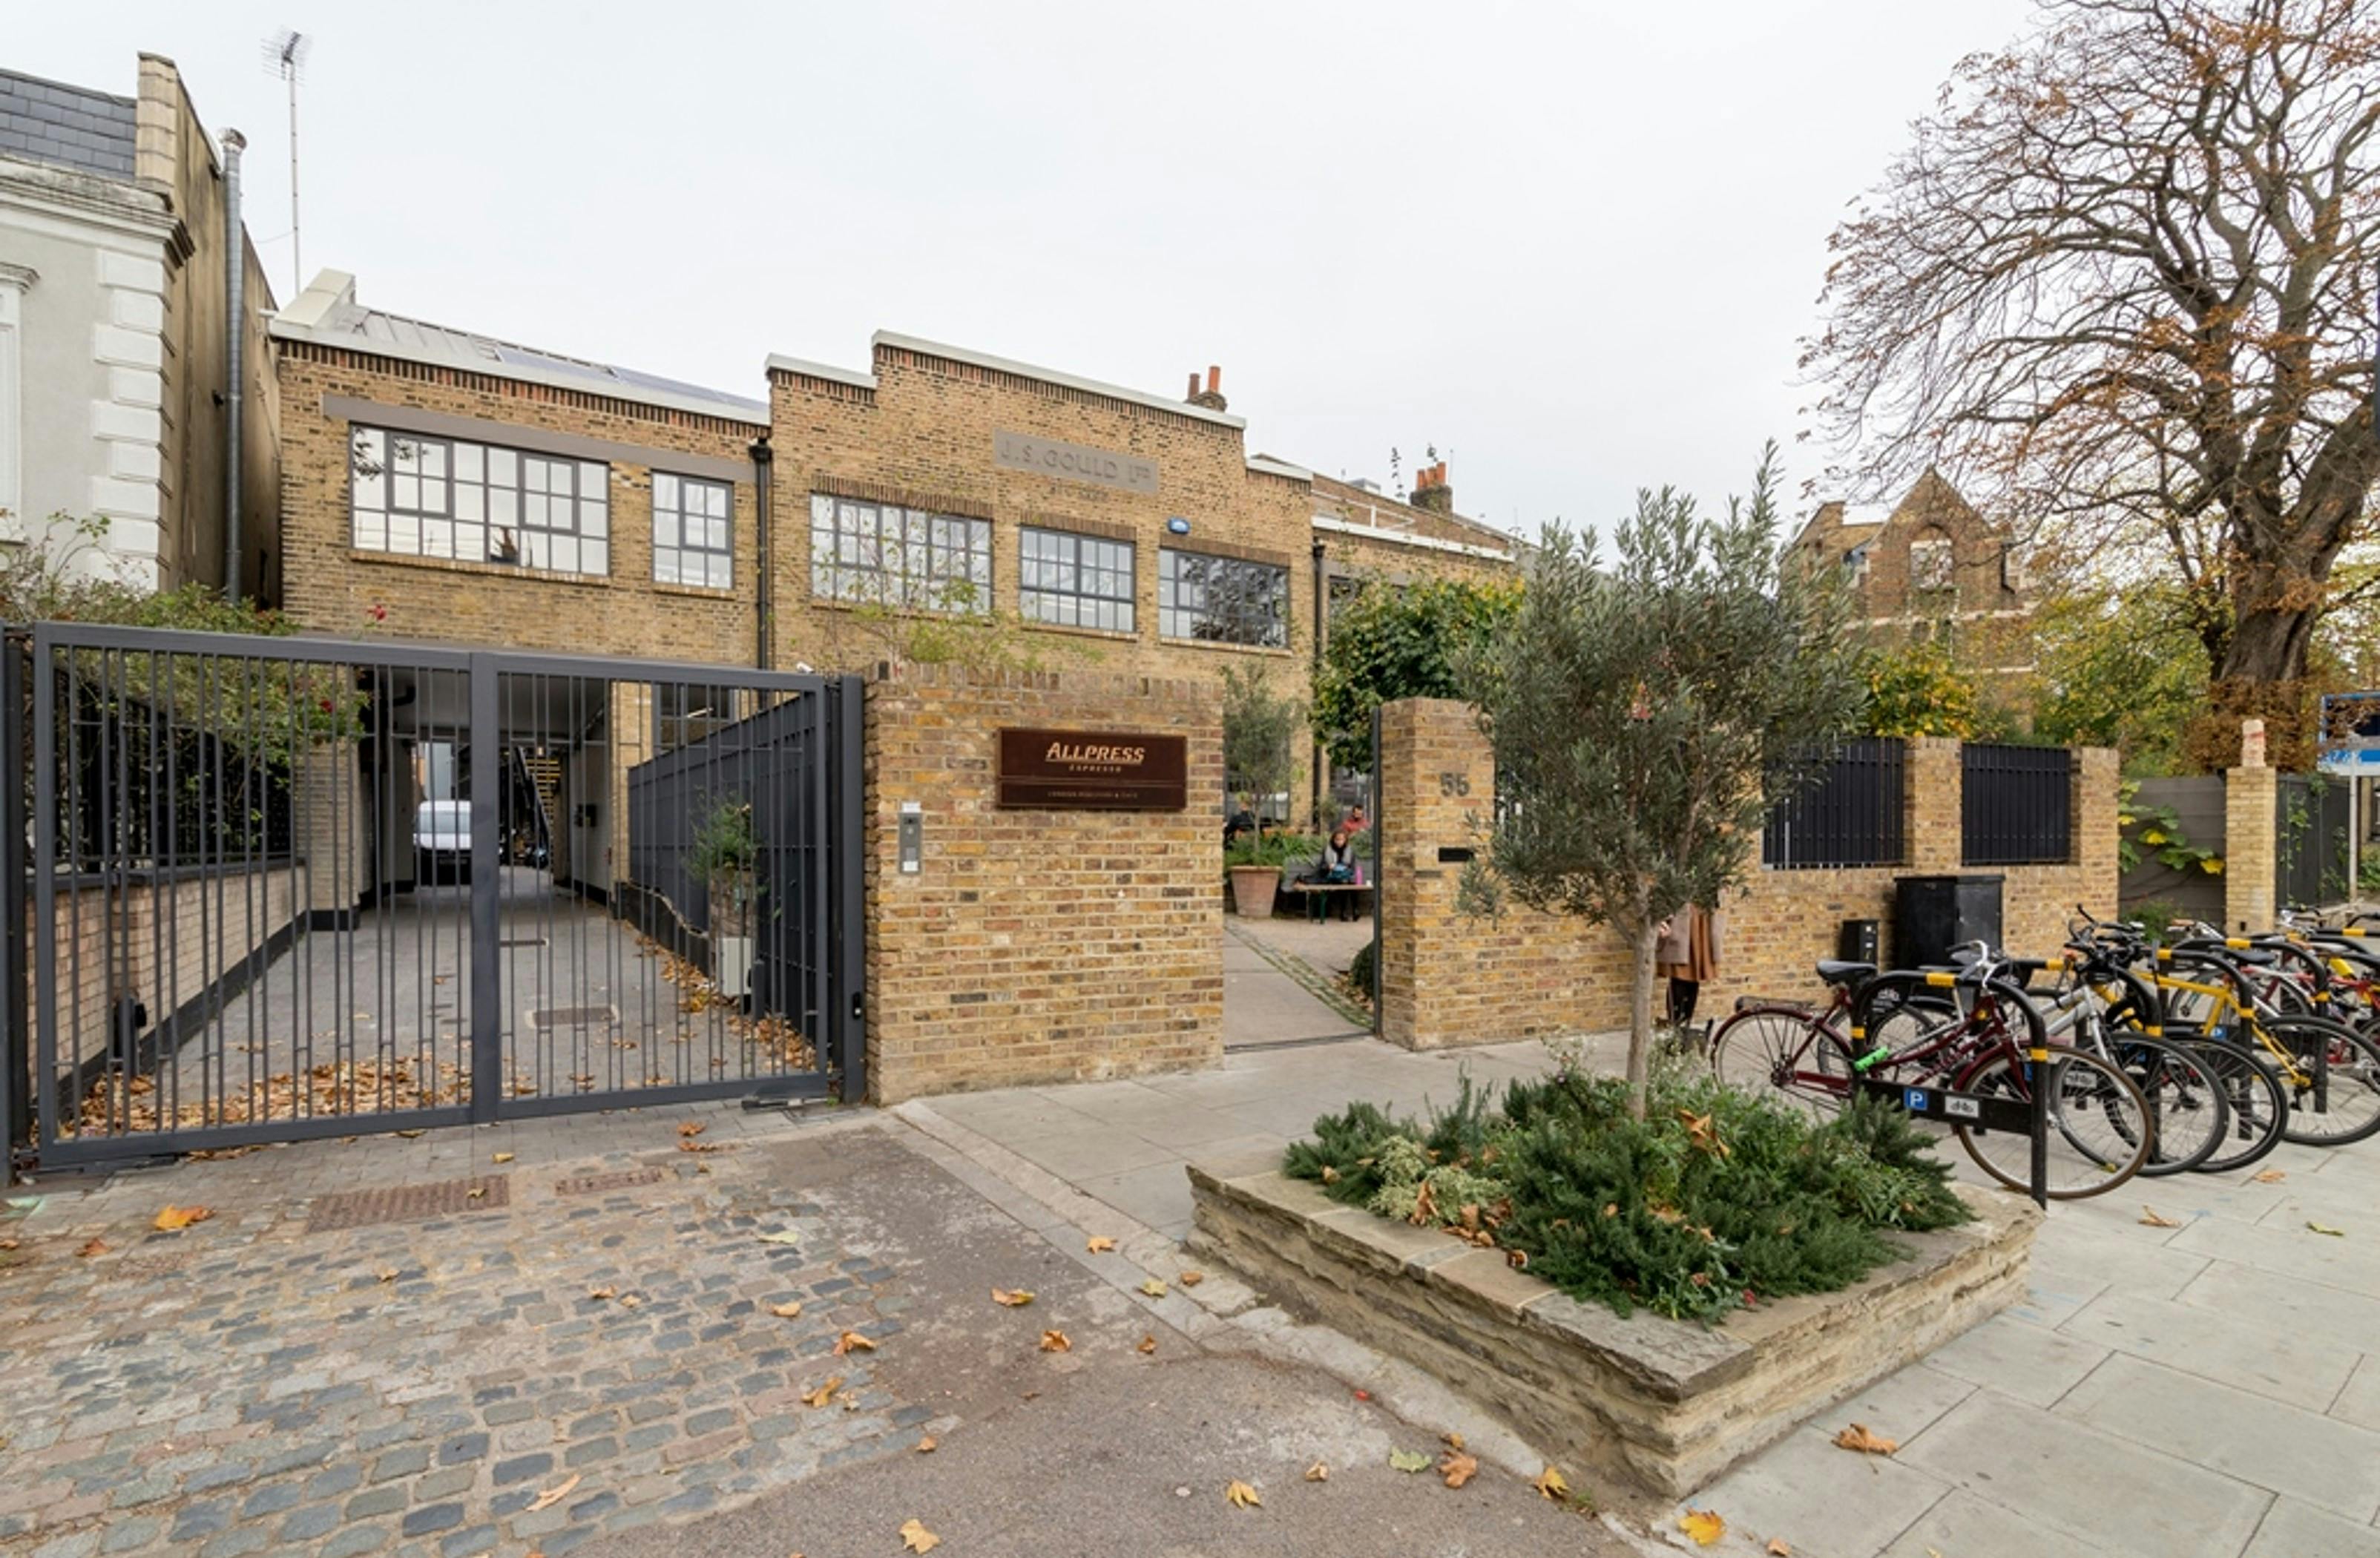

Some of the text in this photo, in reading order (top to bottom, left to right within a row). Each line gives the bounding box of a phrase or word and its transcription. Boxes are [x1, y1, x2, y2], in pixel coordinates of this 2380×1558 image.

[1047, 742, 1145, 763] ALLPRESS
[1441, 772, 1470, 796] 55
[1910, 1091, 1924, 1107] P
